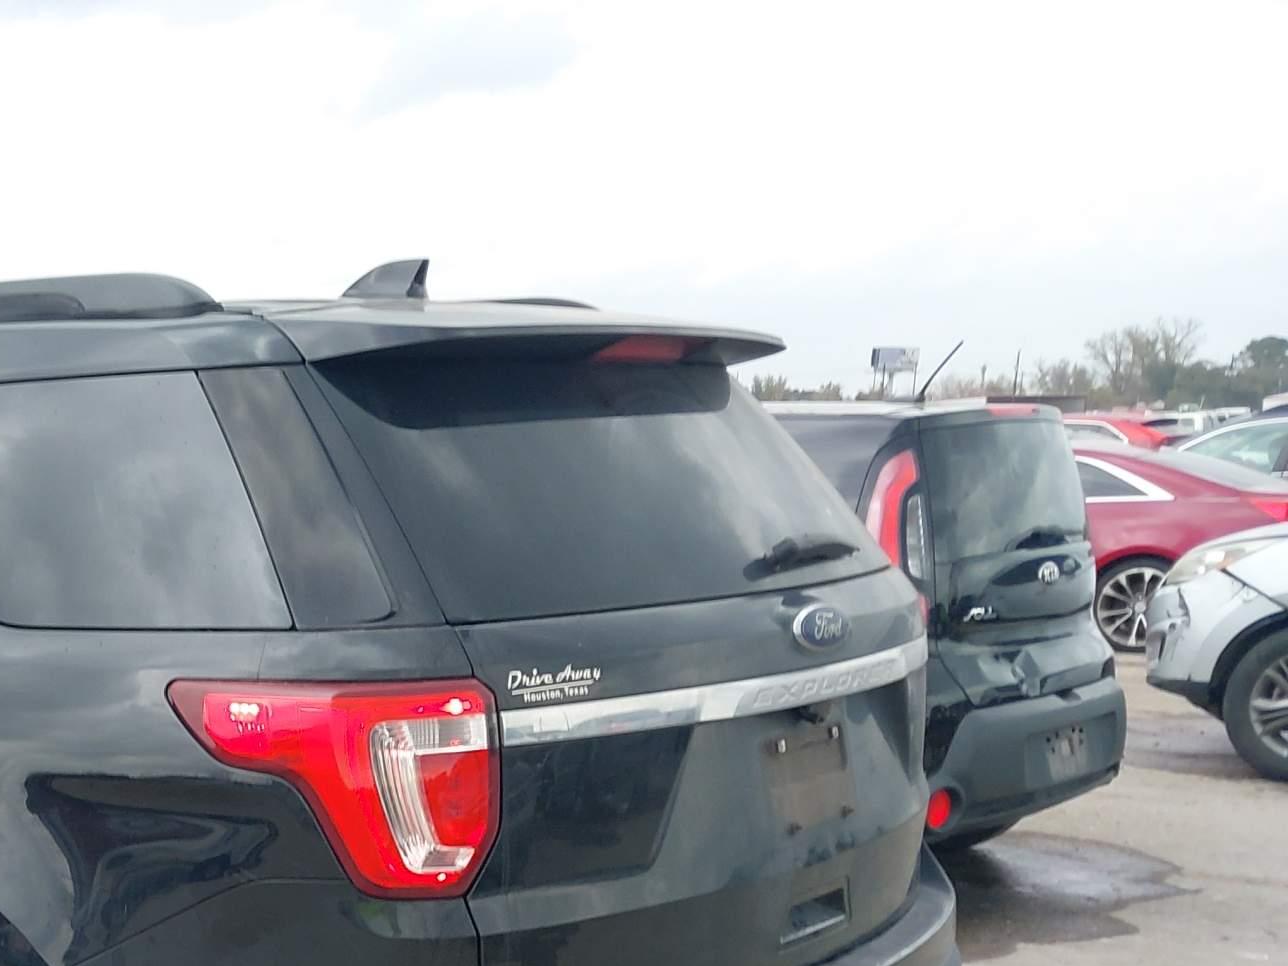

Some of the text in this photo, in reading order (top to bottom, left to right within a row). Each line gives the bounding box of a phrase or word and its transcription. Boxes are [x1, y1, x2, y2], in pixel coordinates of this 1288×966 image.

[814, 611, 842, 640] Ford
[507, 663, 601, 690] Drive Away
[523, 685, 589, 703] Houston, Texas
